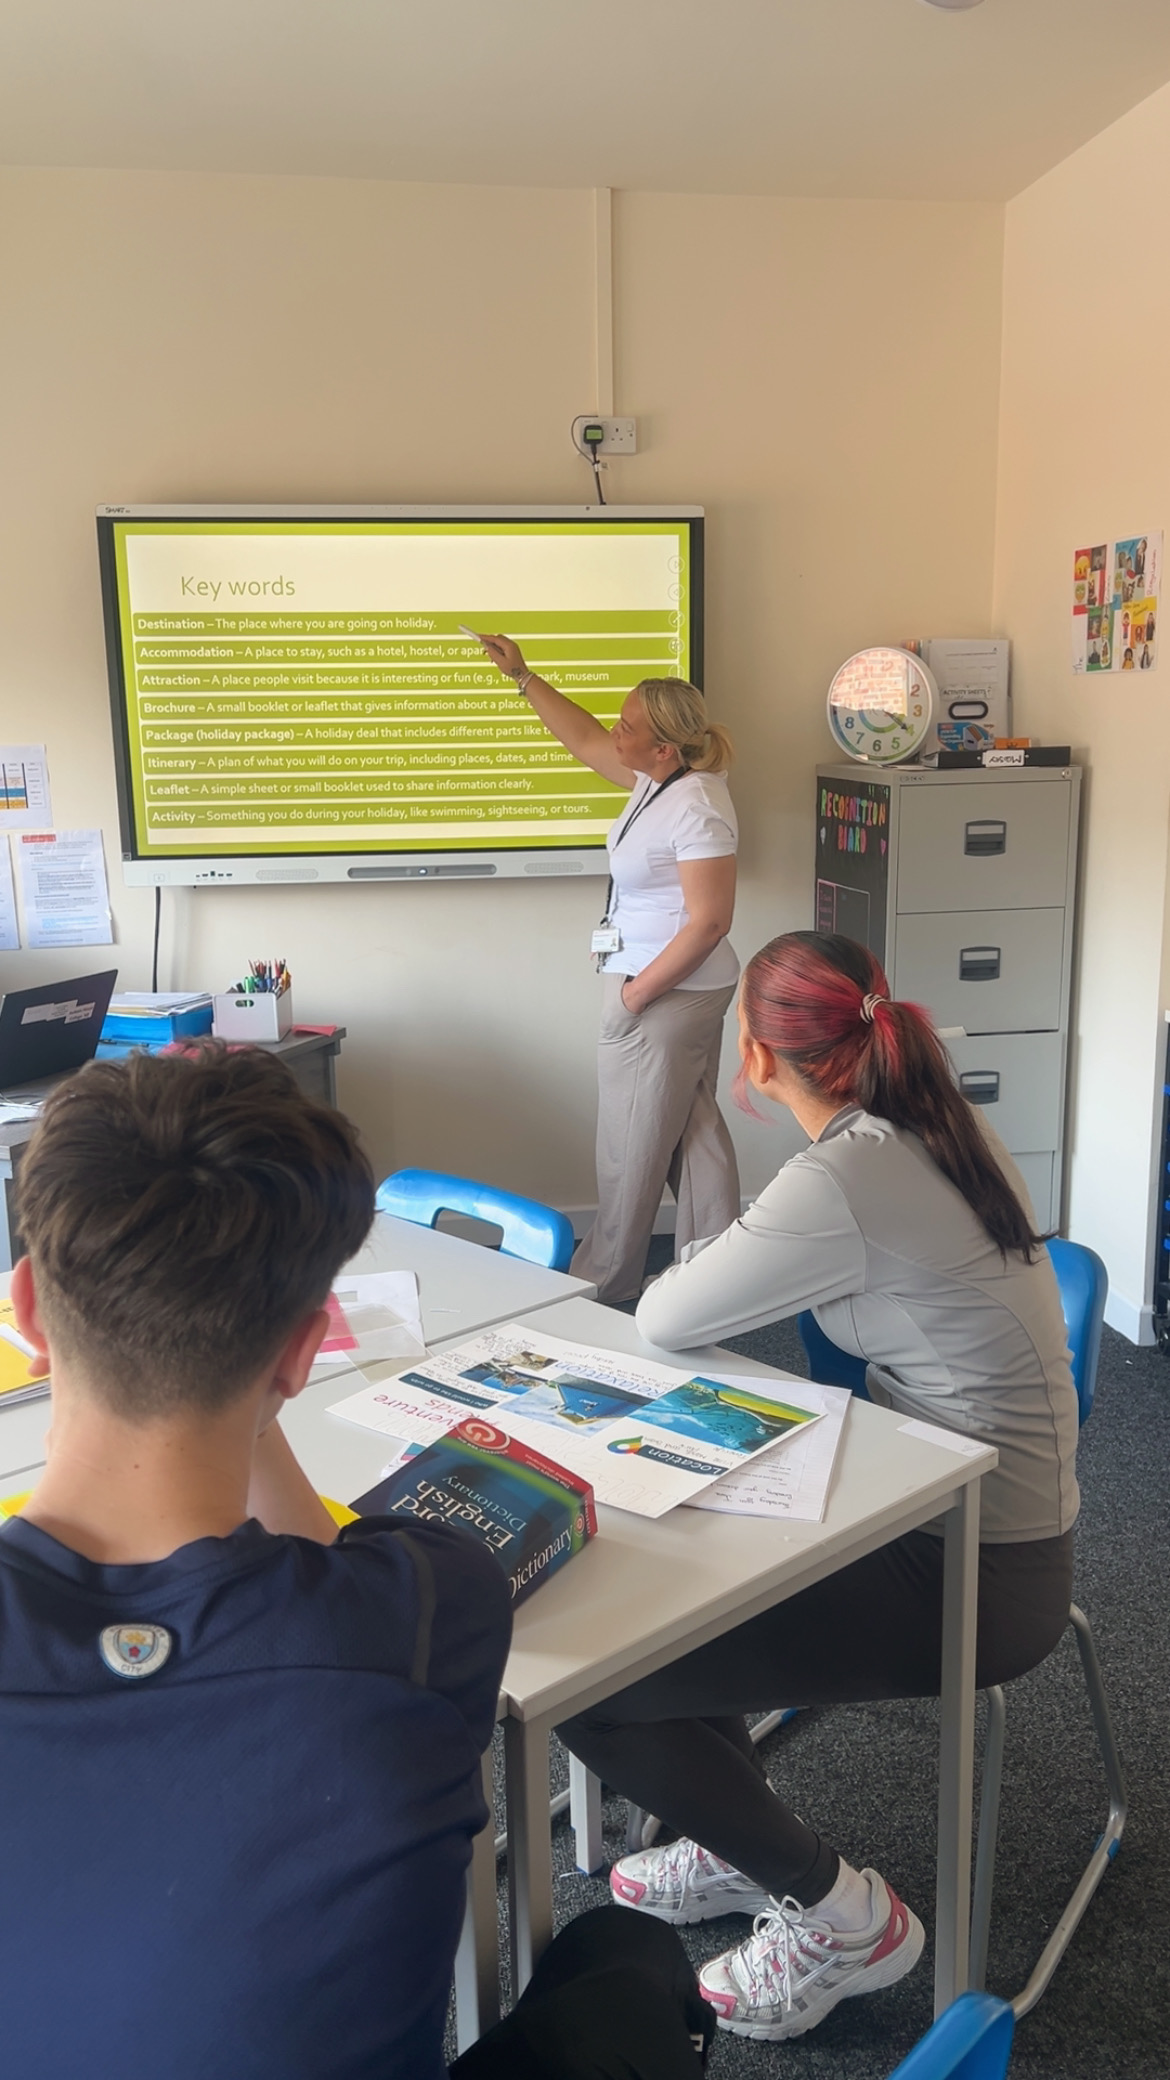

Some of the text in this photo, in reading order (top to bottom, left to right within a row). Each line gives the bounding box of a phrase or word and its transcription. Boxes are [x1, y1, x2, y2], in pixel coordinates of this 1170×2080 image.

[181, 575, 296, 601] Key words
[137, 618, 205, 630] Destination
[214, 618, 237, 630] The
[238, 618, 267, 632] place
[269, 617, 303, 629] where
[305, 620, 326, 631] you
[327, 620, 345, 629] are
[346, 618, 378, 632] going
[379, 619, 393, 628] on
[395, 617, 436, 631] holiday.
[140, 646, 234, 658] Accommodation
[244, 646, 254, 658] A
[255, 646, 284, 660] place
[286, 647, 298, 657] to
[300, 647, 325, 659] stay,
[327, 645, 352, 657] such
[354, 648, 366, 657] as
[368, 648, 375, 657] a
[376, 645, 407, 658] hotel,
[409, 645, 445, 658] hostel,
[447, 647, 459, 656] or
[142, 674, 200, 686] Attraction
[211, 674, 220, 685] A
[222, 673, 251, 687] place
[253, 673, 290, 687] people
[291, 673, 314, 684] visit
[316, 673, 360, 684] because
[361, 673, 370, 683] it
[371, 673, 380, 684] is
[382, 673, 438, 687] interesting
[440, 674, 452, 683] or
[453, 671, 471, 683] fun
[473, 671, 499, 685] (e.g.,
[565, 673, 609, 681] museum
[910, 683, 920, 697] 2
[143, 701, 196, 713] Brochure
[206, 702, 215, 713] A
[217, 701, 246, 713] small
[248, 701, 289, 712] booklet
[291, 703, 303, 712] or
[304, 700, 339, 712] leaflet
[340, 700, 363, 712] that
[364, 701, 392, 714] gives
[394, 699, 456, 711] information
[457, 699, 488, 710] about
[489, 701, 496, 709] a
[498, 695, 525, 712] place
[913, 704, 923, 717] 3
[845, 716, 855, 729] 8
[146, 729, 194, 744] Package
[196, 728, 242, 743] (holiday
[244, 728, 294, 742] package)
[304, 728, 314, 739] A
[315, 727, 354, 742] holiday
[356, 727, 378, 738] deal
[380, 727, 403, 738] that
[404, 726, 447, 738] includes
[448, 725, 494, 737] different
[496, 727, 522, 739] parts
[523, 725, 543, 736] like
[856, 731, 865, 745] 7
[891, 737, 900, 750] 5
[872, 739, 882, 752] 6
[148, 757, 196, 771] Itinerary
[207, 757, 216, 767] A
[218, 756, 241, 770] plan
[243, 755, 254, 767] of
[256, 755, 284, 767] what
[285, 757, 306, 768] you
[307, 755, 326, 766] will
[328, 755, 342, 766] do
[344, 757, 358, 765] on
[359, 757, 384, 768] your
[385, 754, 407, 767] trip,
[409, 753, 457, 767] including
[458, 752, 493, 766] places,
[495, 752, 526, 765] dates,
[528, 751, 548, 763] and
[149, 783, 190, 795] Leaflet
[200, 784, 209, 794] A
[211, 783, 246, 797] simple
[248, 782, 278, 794] sheet
[280, 784, 292, 793] or
[294, 781, 322, 793] small
[324, 781, 364, 793] booklet
[366, 780, 391, 792] used
[392, 782, 404, 791] to
[406, 780, 434, 791] share
[436, 779, 496, 790] information
[498, 778, 534, 792] clearly.
[152, 810, 196, 825] Activity
[206, 809, 266, 824] Something
[267, 811, 288, 822] you
[289, 809, 304, 820] do
[305, 808, 340, 822] during
[341, 810, 366, 821] your
[367, 807, 408, 820] holiday,
[410, 806, 428, 817] like
[430, 805, 486, 821] swimming,
[488, 804, 548, 820] sightseeing,
[550, 806, 561, 814] or
[562, 804, 592, 813] tours.
[820, 788, 886, 827] RECOGNITION
[837, 824, 868, 854] BOARD
[554, 1362, 664, 1399] Relaxation
[648, 1447, 722, 1475] Location
[443, 1476, 527, 1532] Dictionary
[415, 1480, 515, 1550] English
[120, 1664, 142, 1674] CITY
